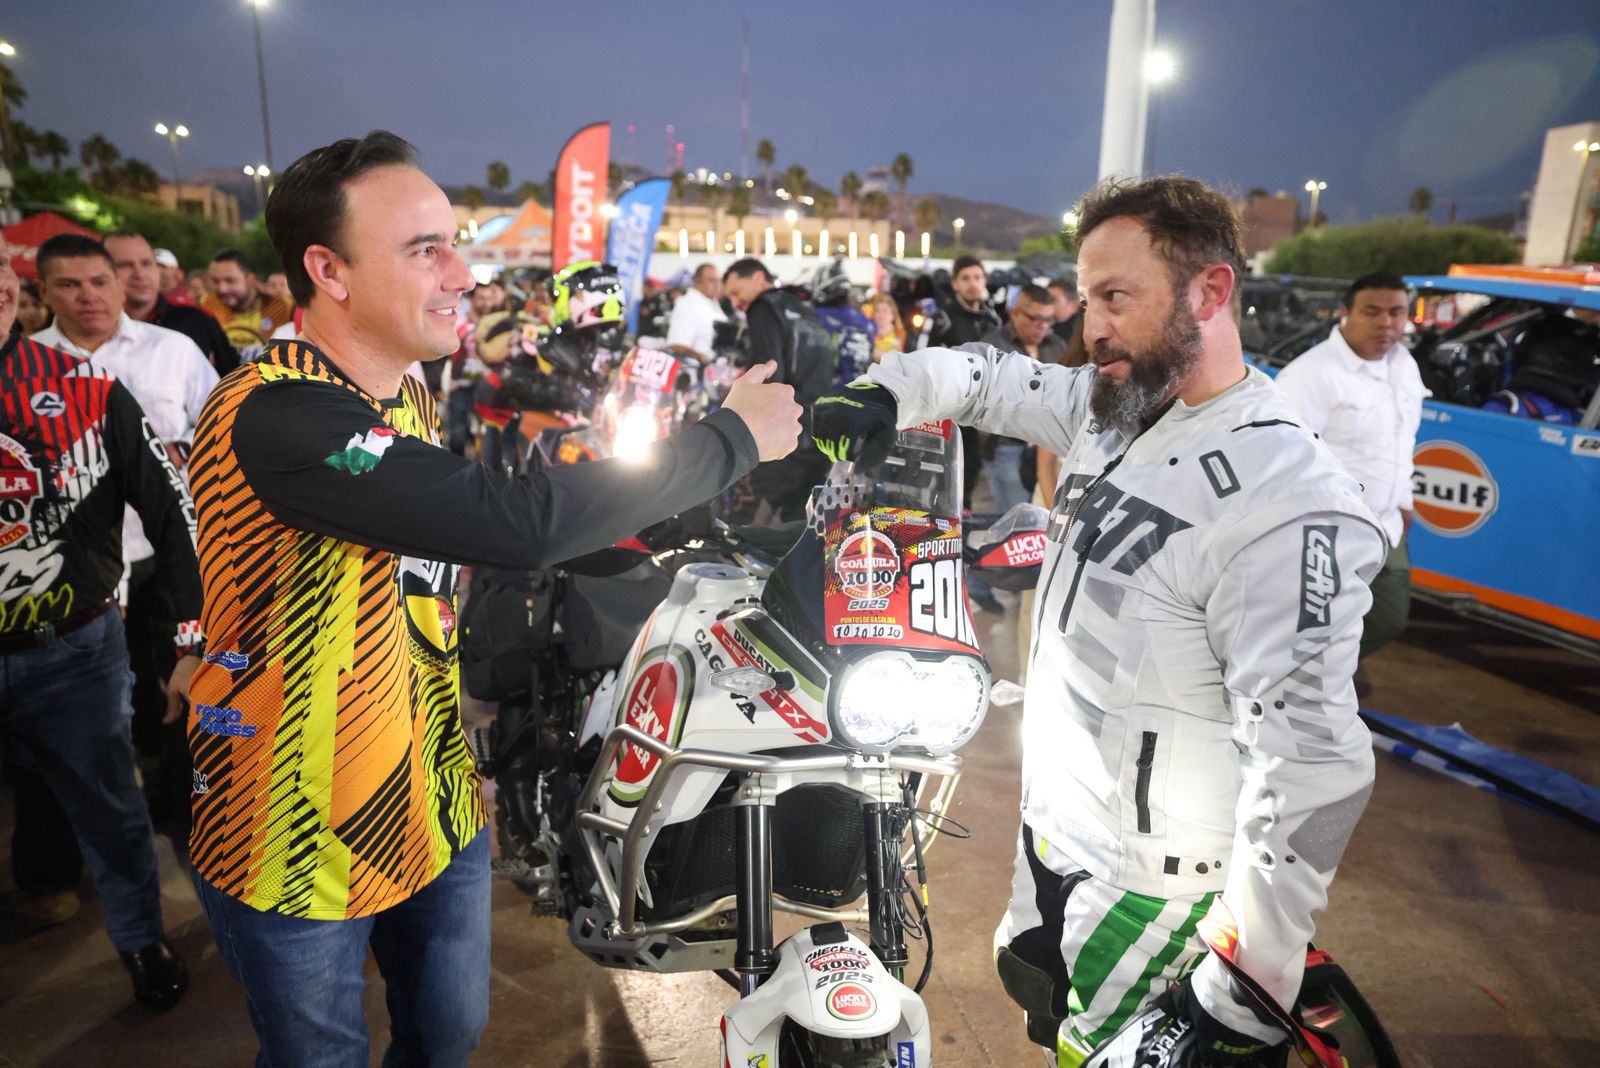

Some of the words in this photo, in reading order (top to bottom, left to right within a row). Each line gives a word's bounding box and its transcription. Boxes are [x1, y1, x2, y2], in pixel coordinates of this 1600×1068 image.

[1411, 471, 1490, 508] Gulf
[839, 558, 896, 569] COAHUILA
[1008, 549, 1046, 566] EXPLOR
[846, 570, 892, 586] 1000
[848, 599, 888, 610] 2025
[836, 625, 850, 639] 10
[855, 626, 868, 639] 10
[872, 625, 884, 637] 10
[887, 626, 901, 638] 10
[821, 960, 868, 973] 1000
[815, 972, 874, 990] 2025
[834, 993, 868, 1004] LUCKY
